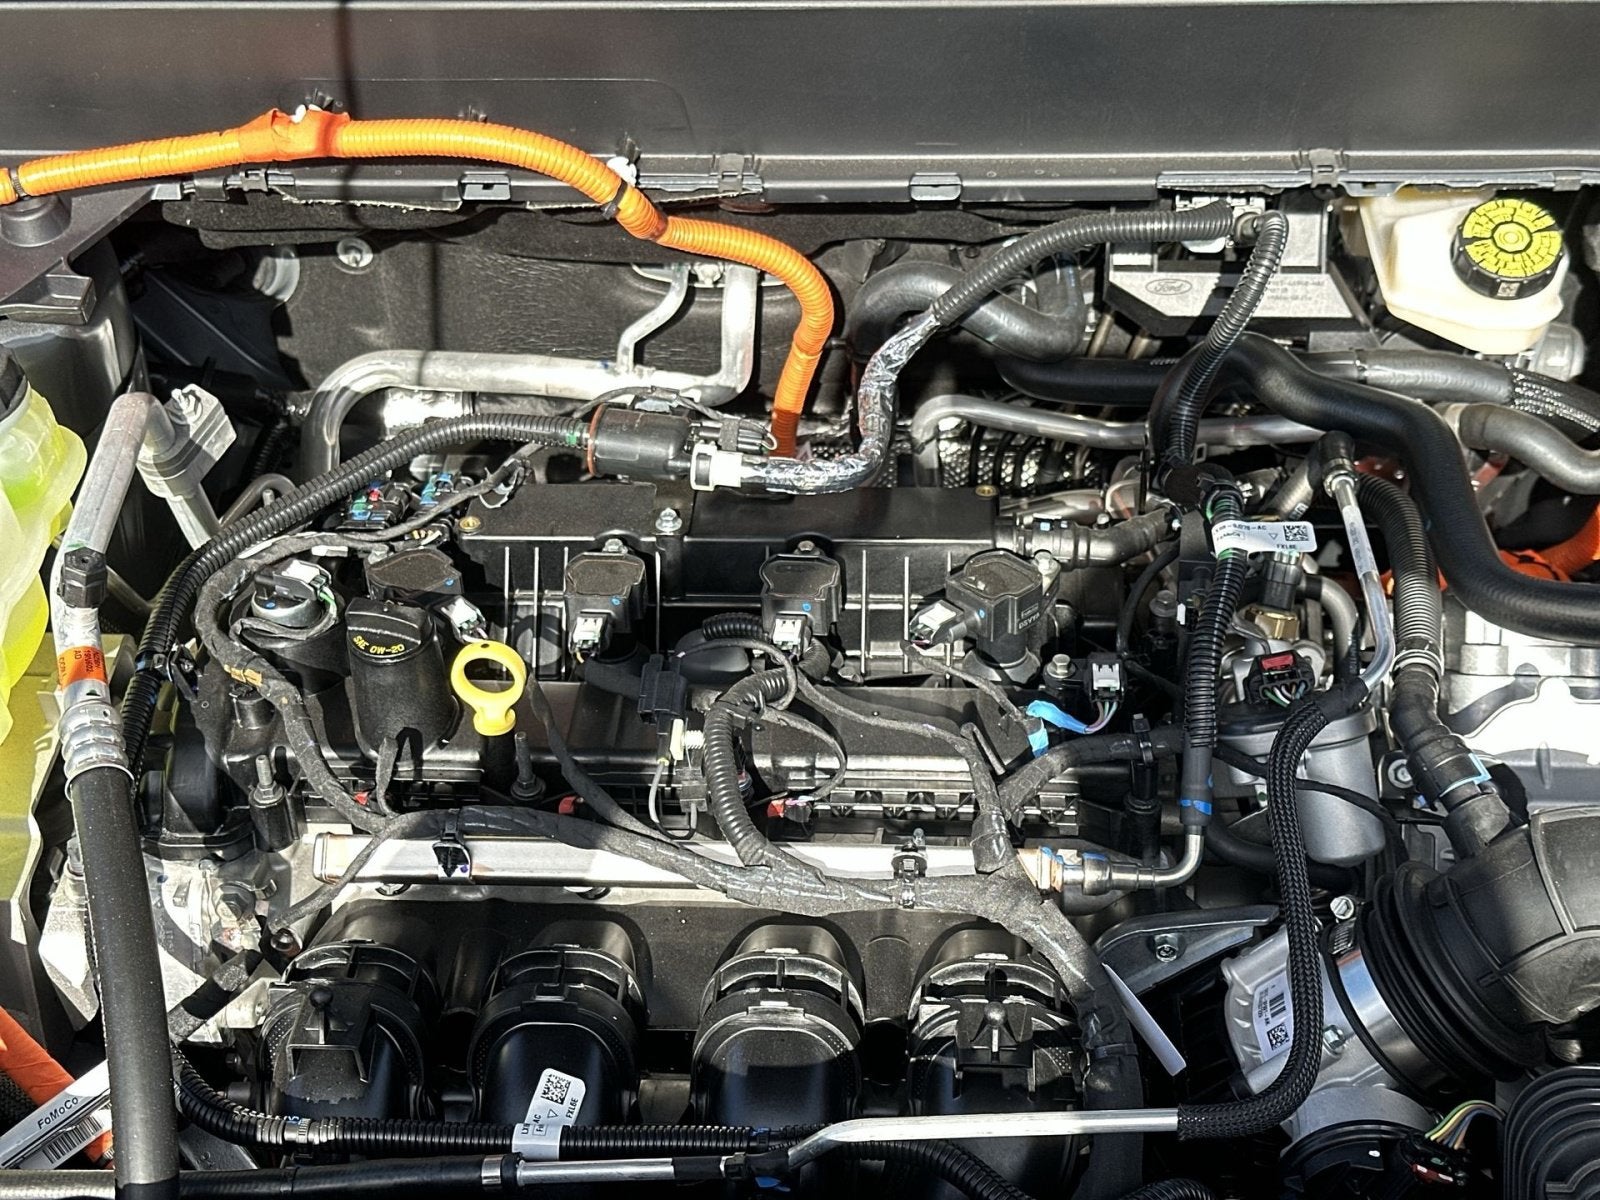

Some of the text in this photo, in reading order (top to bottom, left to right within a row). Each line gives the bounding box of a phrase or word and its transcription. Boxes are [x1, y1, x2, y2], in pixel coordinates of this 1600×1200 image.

[1154, 281, 1184, 293] Ford
[352, 635, 405, 655] SAE 0W-20
[37, 1096, 79, 1129] FoMoCo
[565, 1097, 579, 1118] FXL6E
